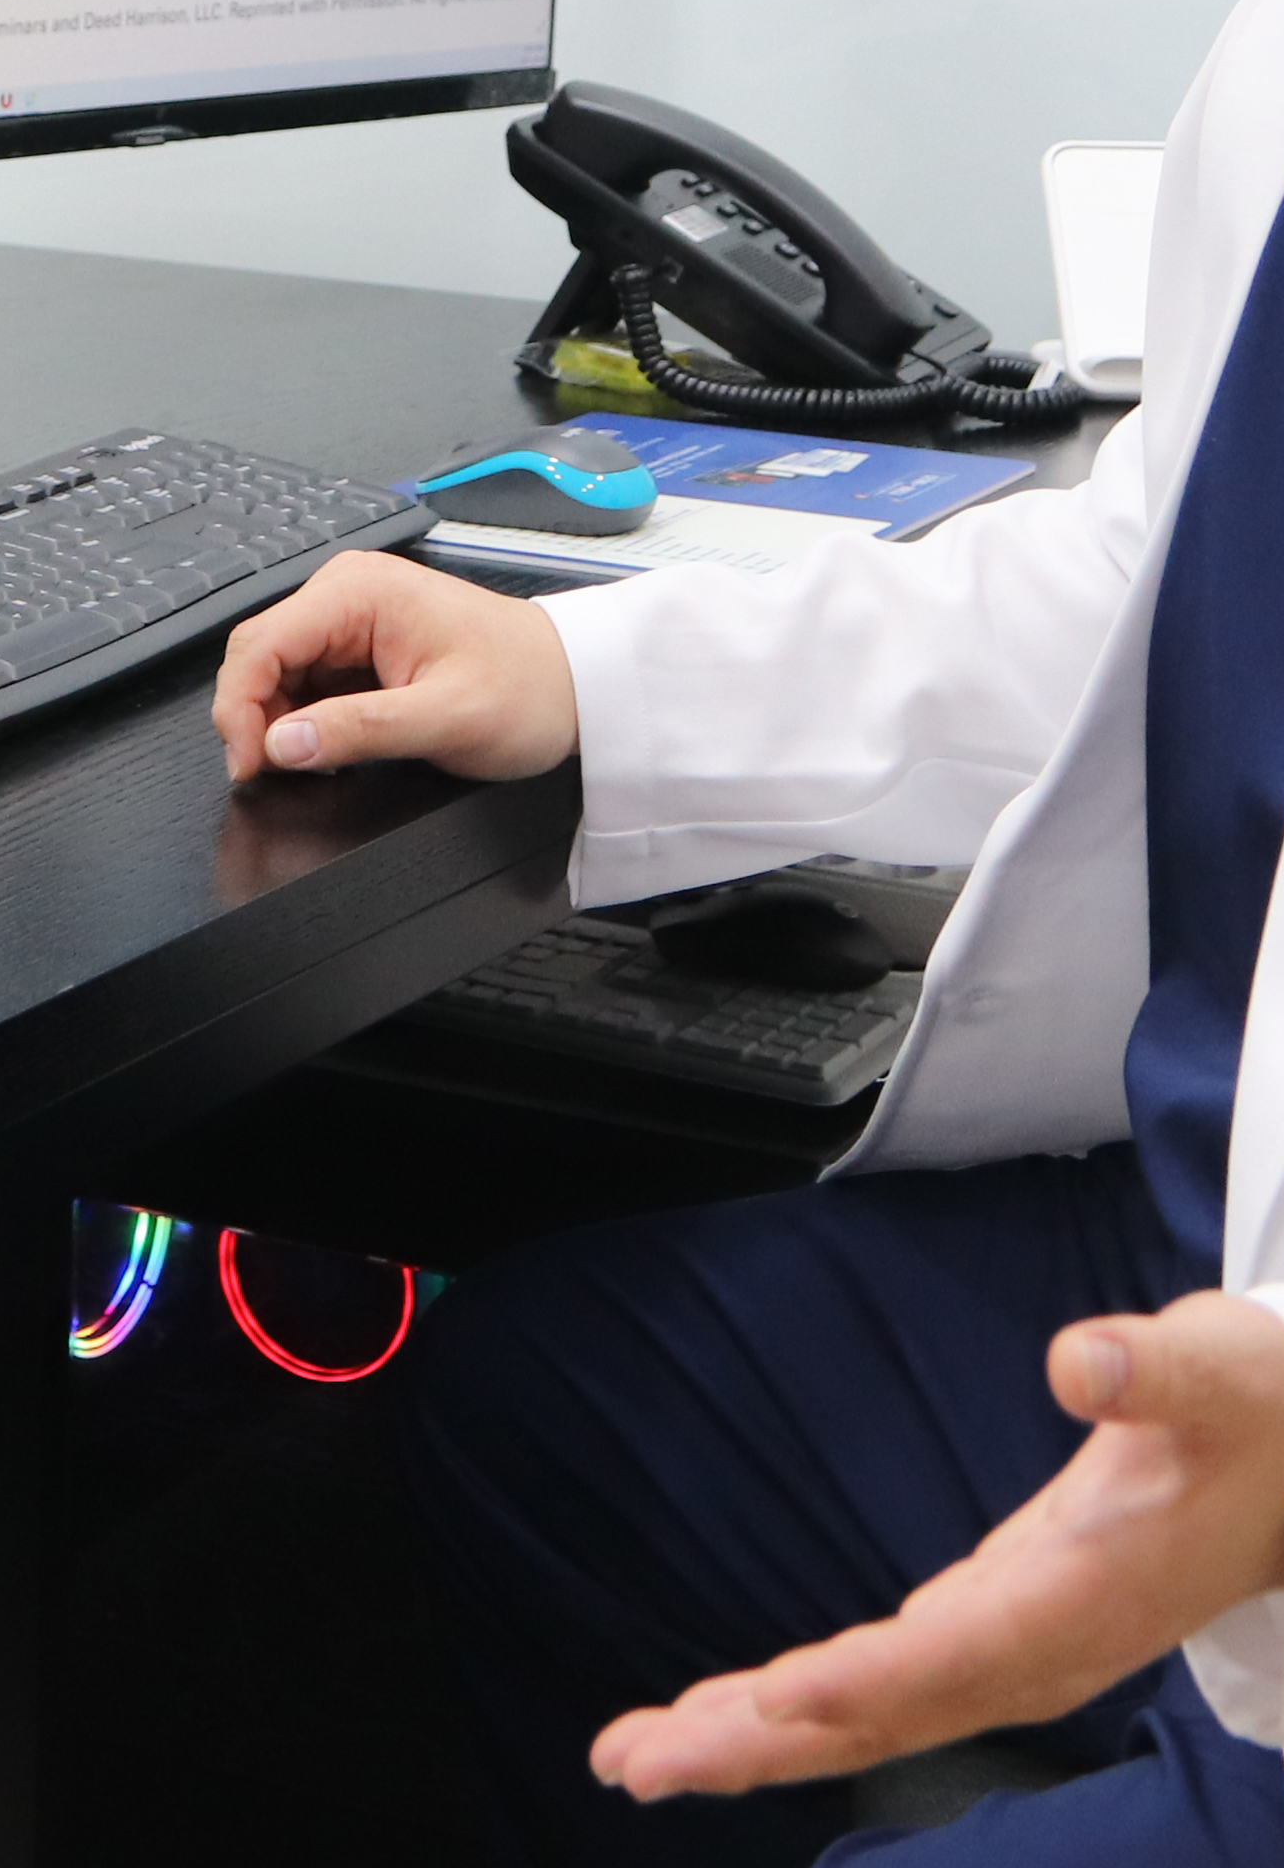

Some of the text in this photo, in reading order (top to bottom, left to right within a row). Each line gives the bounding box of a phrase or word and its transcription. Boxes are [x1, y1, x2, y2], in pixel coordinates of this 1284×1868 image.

[52, 13, 80, 32] and
[83, 10, 121, 30] Deed
[125, 6, 190, 25] Harrison,
[229, 0, 295, 22] Reprinted
